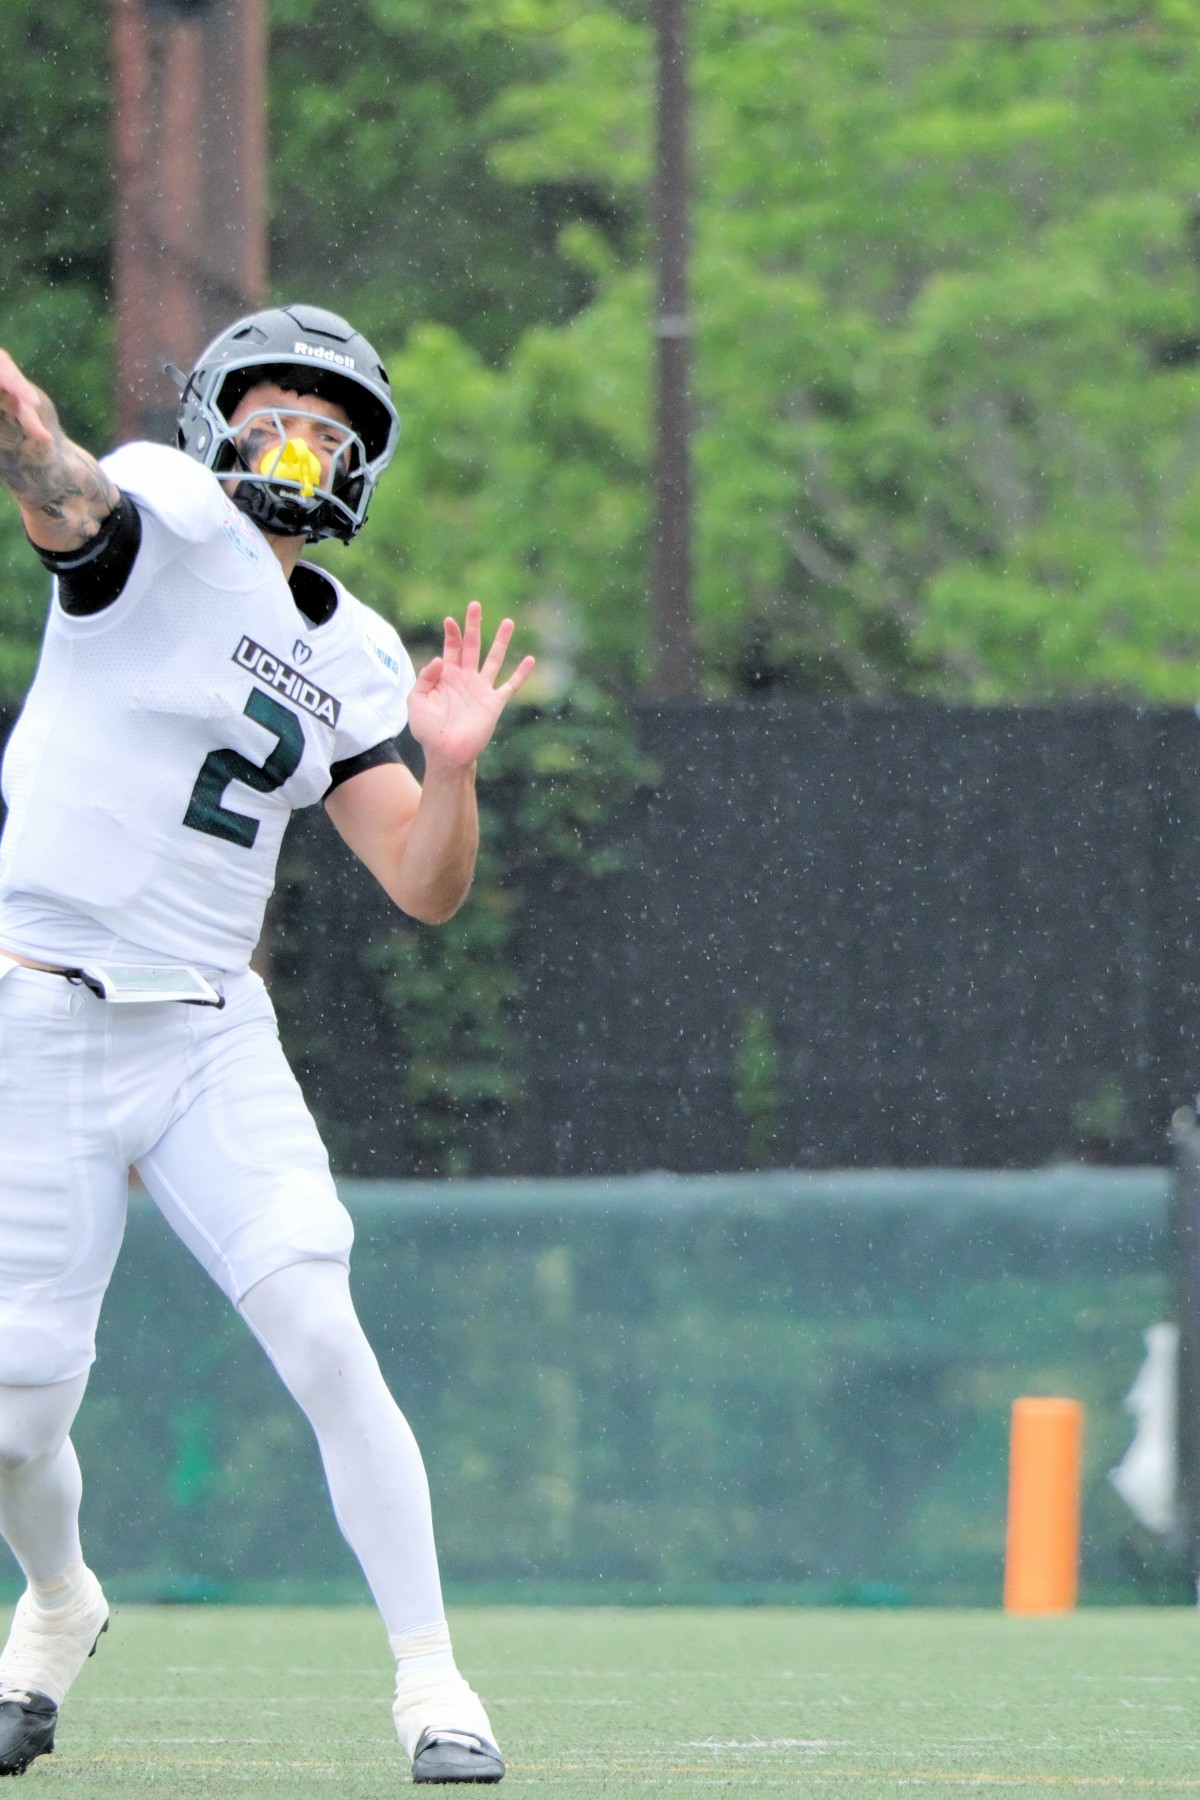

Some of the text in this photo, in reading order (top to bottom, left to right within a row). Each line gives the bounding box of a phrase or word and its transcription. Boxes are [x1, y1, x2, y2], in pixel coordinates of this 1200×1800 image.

[293, 341, 355, 370] Riddell
[235, 639, 336, 726] UCHIDA
[182, 686, 306, 849] 2
